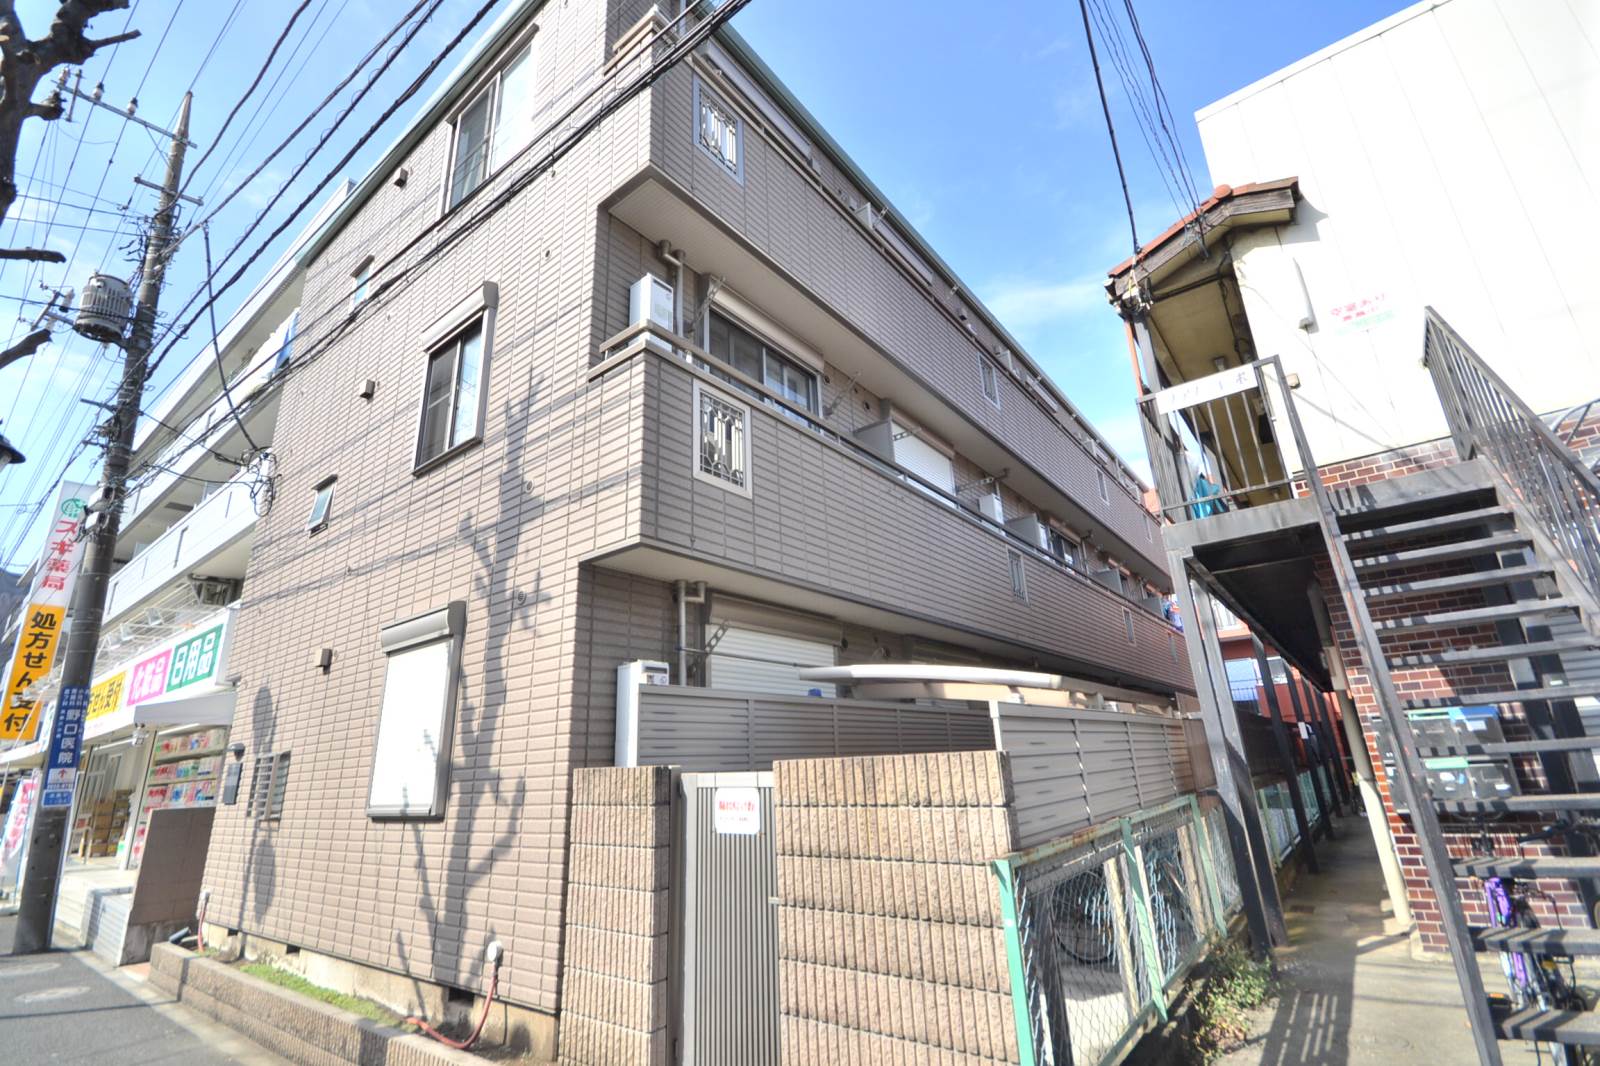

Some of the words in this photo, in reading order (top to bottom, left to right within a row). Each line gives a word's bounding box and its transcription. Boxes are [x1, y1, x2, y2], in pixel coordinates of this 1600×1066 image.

[42, 520, 78, 591] スギ薬局
[131, 656, 166, 701] 化粧品
[171, 632, 215, 687] 日用品
[58, 709, 80, 764] 野口医院
